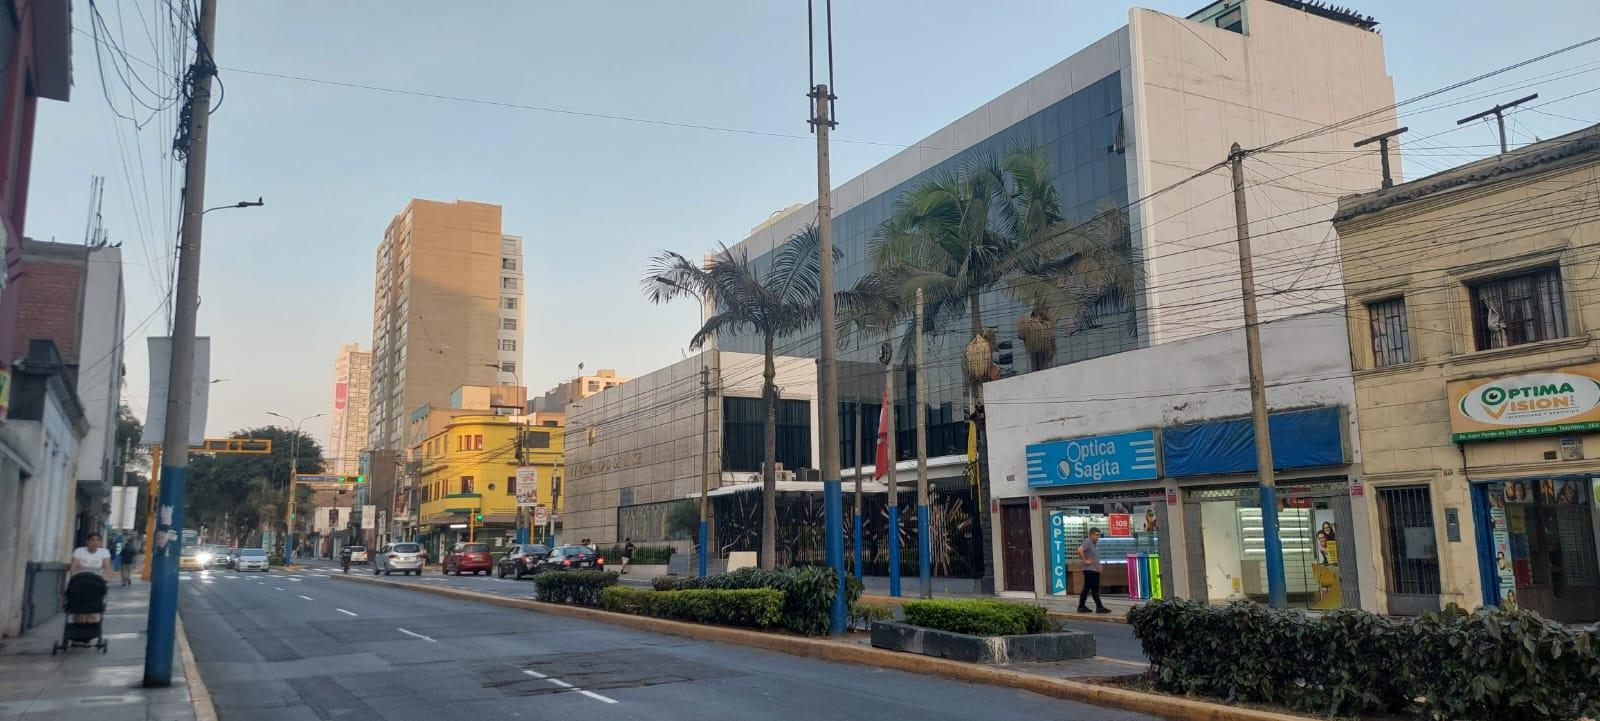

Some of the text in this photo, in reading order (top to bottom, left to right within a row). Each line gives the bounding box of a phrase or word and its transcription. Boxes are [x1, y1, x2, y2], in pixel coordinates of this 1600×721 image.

[1481, 382, 1575, 406] OPTIMA
[1480, 396, 1569, 420] VISION
[1066, 439, 1115, 463] Optica
[1074, 459, 1120, 481] Sagita
[1052, 516, 1065, 589] OPTICA
